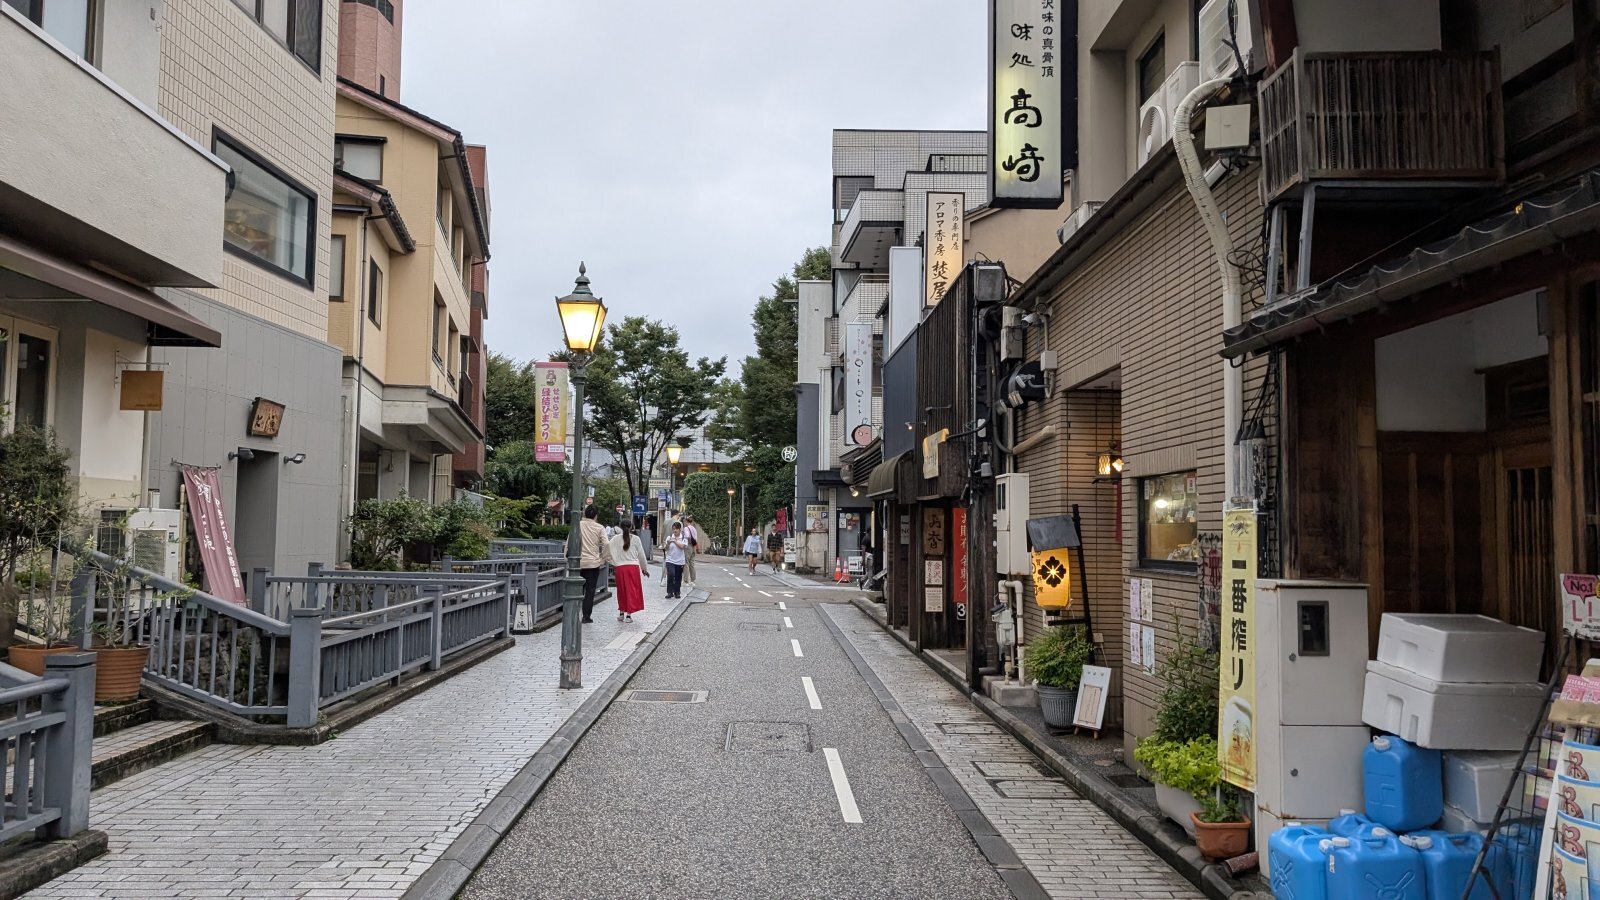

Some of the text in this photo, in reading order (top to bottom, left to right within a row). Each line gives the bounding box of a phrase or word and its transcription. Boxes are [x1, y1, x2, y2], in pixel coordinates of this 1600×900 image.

[1009, 23, 1035, 68] 味処
[934, 201, 946, 257] アロマ香房
[951, 198, 960, 251] 香りの専門店
[928, 514, 942, 549] お香
[1570, 580, 1592, 592] No.1
[1231, 559, 1247, 690] 一番搾り
